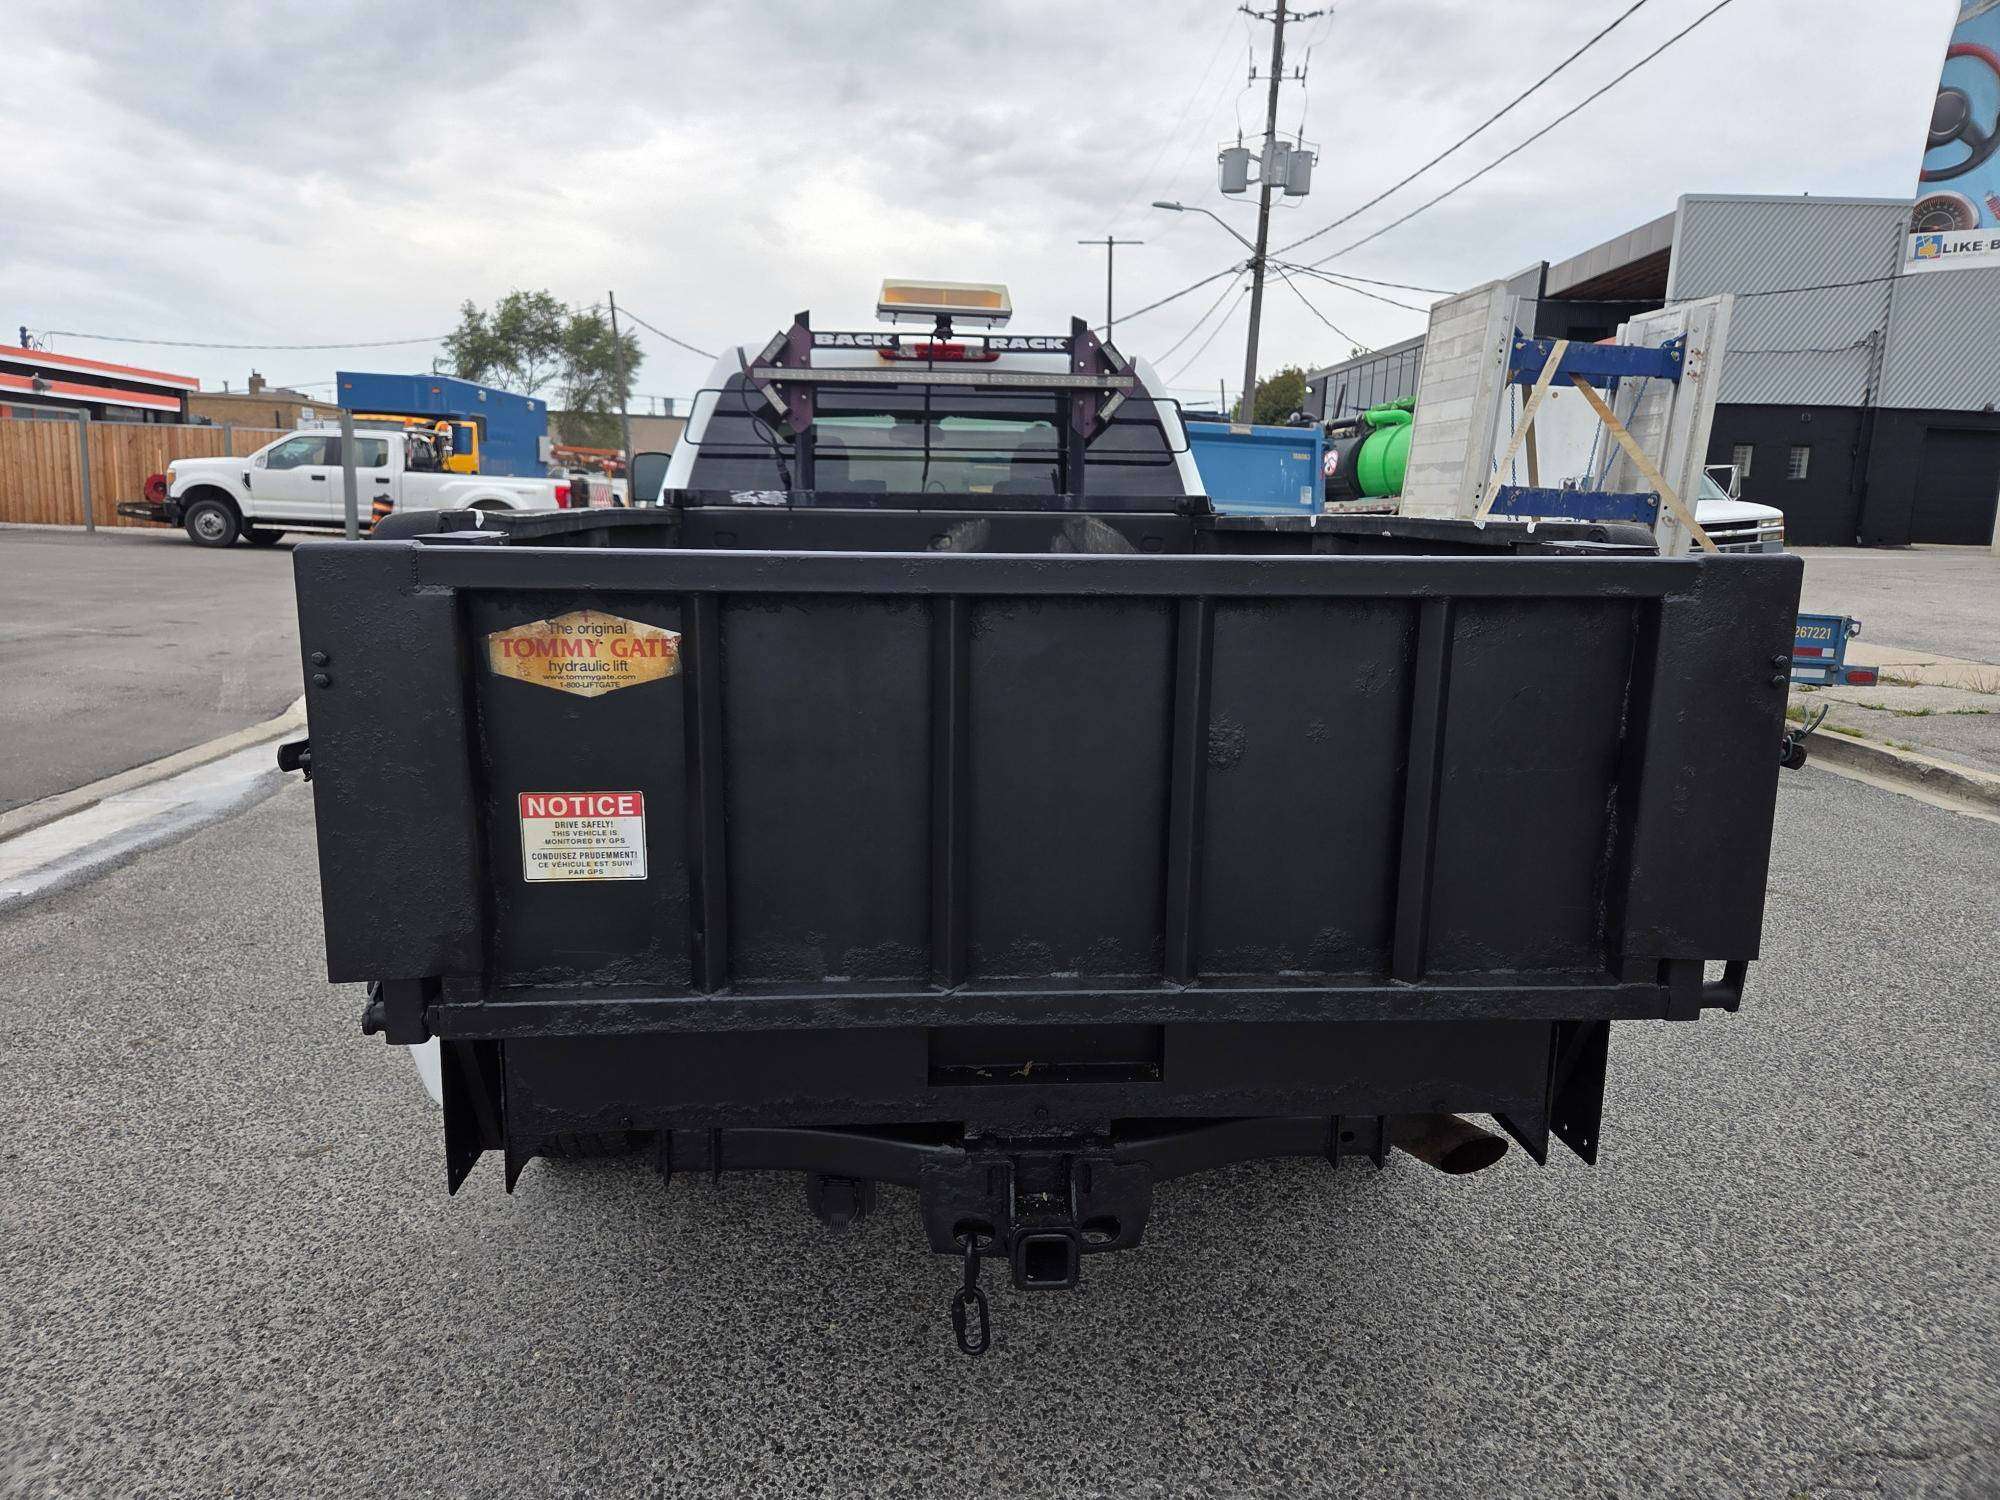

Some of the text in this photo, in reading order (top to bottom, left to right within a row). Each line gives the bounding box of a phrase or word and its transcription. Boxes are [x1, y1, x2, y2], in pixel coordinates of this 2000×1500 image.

[1943, 241, 1983, 254] LIKE
[814, 334, 1067, 350] BACK RACK
[549, 623, 627, 637] The original
[500, 638, 675, 658] TOMMY GATE
[548, 660, 628, 674] hydraulic lift
[527, 796, 634, 816] NOTICE
[554, 821, 614, 829] DRIVE SAFELY!
[531, 851, 638, 860] CONDUISEZ PRUDEMMENT!
